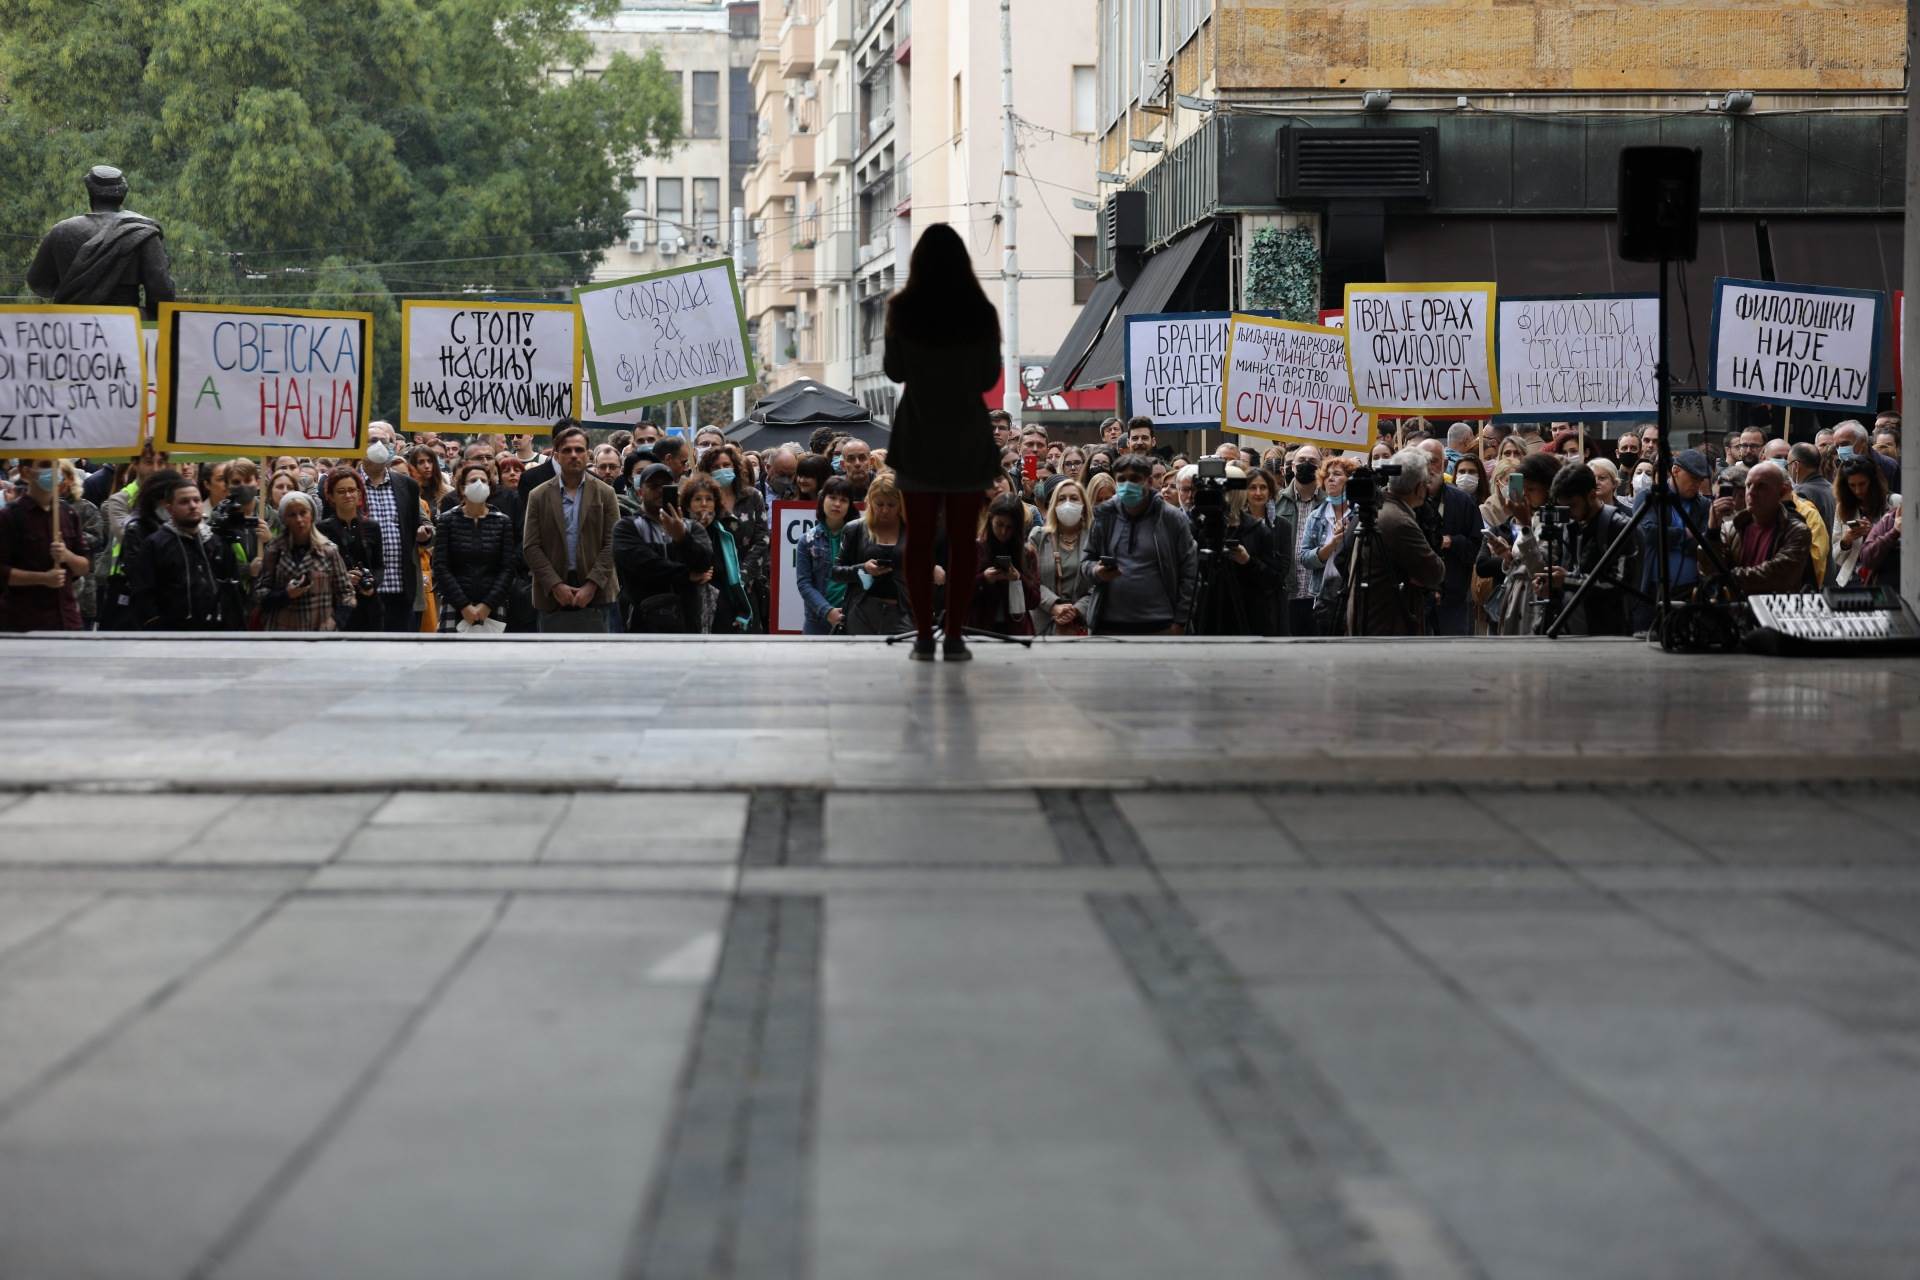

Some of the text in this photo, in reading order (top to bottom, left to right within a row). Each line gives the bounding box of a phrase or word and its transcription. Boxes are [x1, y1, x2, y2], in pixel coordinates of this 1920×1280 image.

[615, 274, 713, 320] СЛОБОДА
[1736, 293, 1855, 332] ФИЛОЛОШКИ
[16, 316, 108, 351] FACOLTÀ
[450, 311, 534, 346] СТОП!
[651, 312, 686, 350] ЗА
[1352, 299, 1398, 334] ТВРД
[1421, 298, 1473, 332] ОРАХ
[1517, 301, 1635, 344] ФИЛОЛОШКИ
[213, 321, 356, 374] СВЕТСКА
[1290, 334, 1345, 356] МАРКОВИ
[1373, 333, 1471, 366] ФИЛОЛОГ
[1757, 326, 1829, 362] НИЈЕ
[27, 353, 127, 381] FILOLOGIA
[439, 345, 537, 383] НАСИЉУ
[616, 338, 739, 393] ФИЛОЛОШКИ
[1145, 354, 1226, 387] АКАДЕМ
[1235, 359, 1329, 383] МИНИСТАРСТВО
[1732, 357, 1868, 401] НА ПРОДАЈУ
[16, 380, 138, 410] NON STA PIÙ
[1259, 376, 1276, 394] НА
[1367, 368, 1480, 402] АНГЛИСТА
[195, 375, 222, 410] А
[260, 377, 356, 439] НАША
[1236, 391, 1363, 435] СЛУЧАЈНО?
[0, 414, 76, 441] ZITTA
